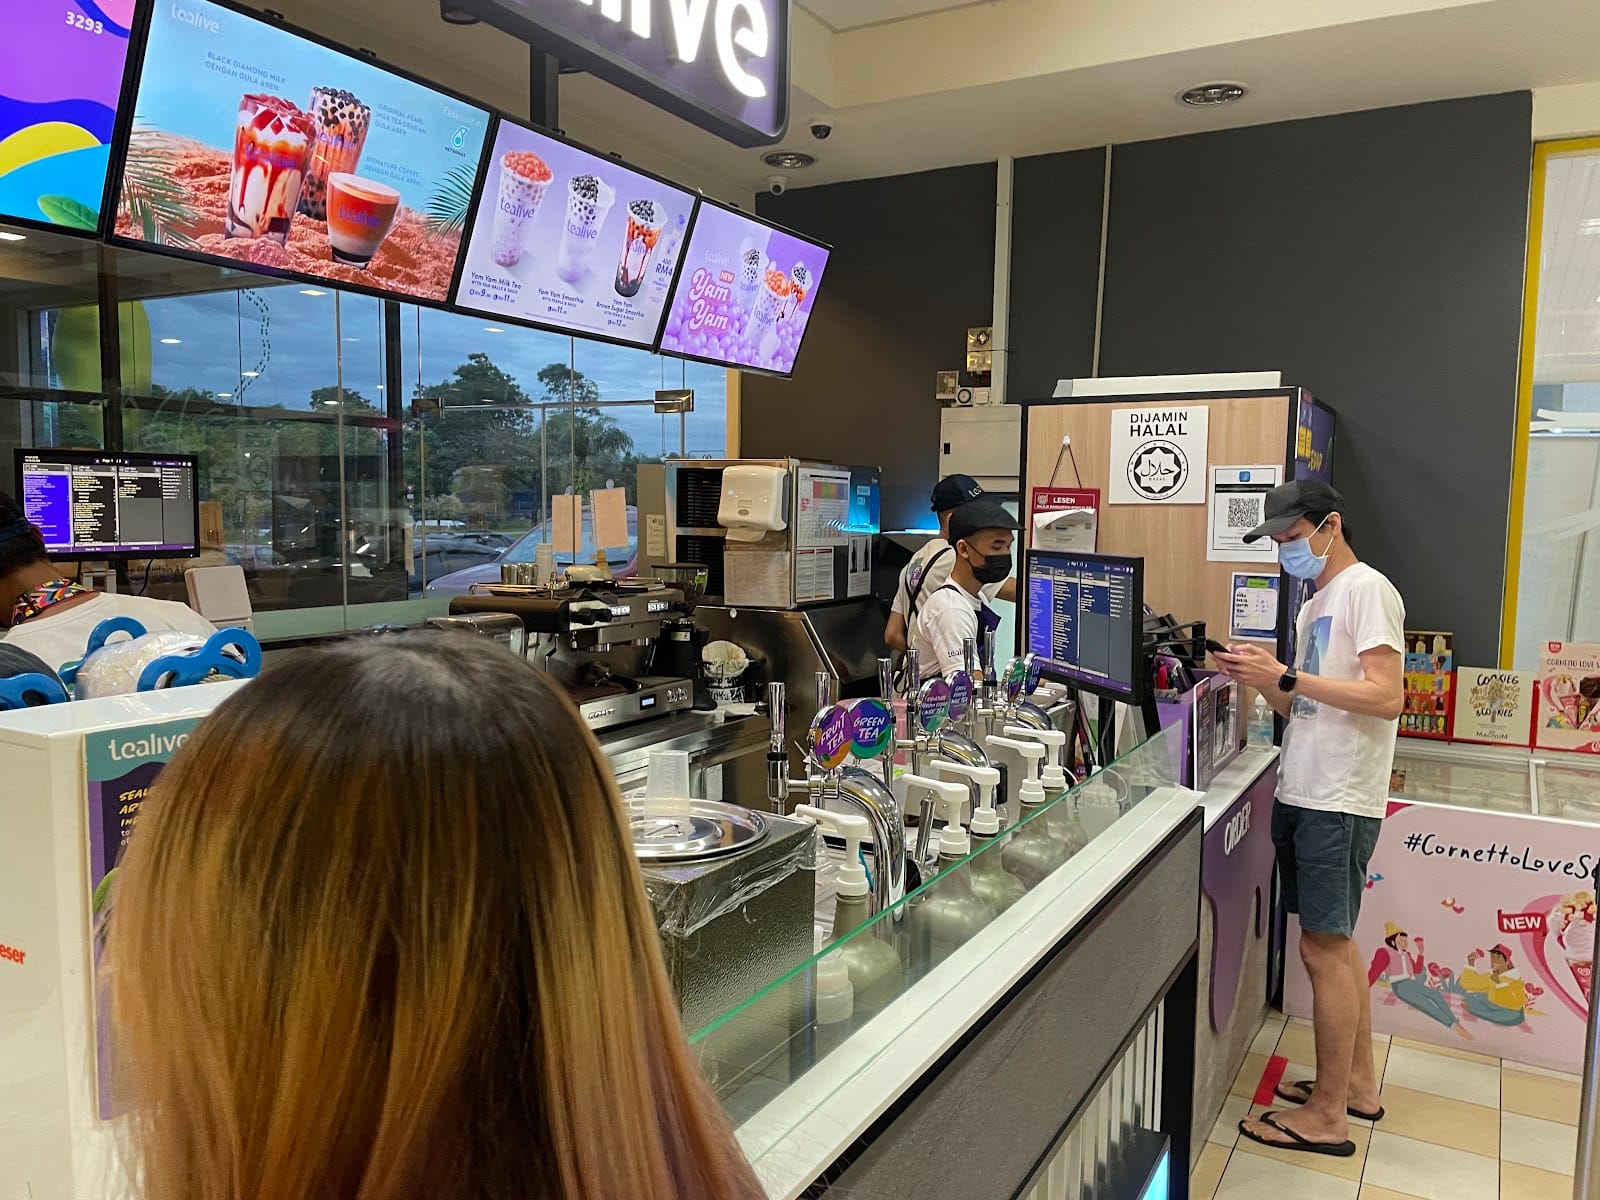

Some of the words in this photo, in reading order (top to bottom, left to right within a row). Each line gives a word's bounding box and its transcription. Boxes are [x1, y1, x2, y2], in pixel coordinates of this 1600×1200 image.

[65, 11, 103, 34] 3293
[172, 4, 220, 33] tealive
[206, 61, 238, 77] DENGAN
[239, 73, 258, 84] GULA
[260, 81, 279, 91] AREN
[208, 52, 232, 64] BLACK
[233, 61, 268, 78] DIAMOND
[270, 74, 286, 83] MILK
[500, 197, 535, 219] tealive
[567, 220, 598, 240] tealive
[472, 272, 484, 280] Yam
[486, 275, 497, 284] Yam
[499, 278, 510, 286] Milk
[689, 268, 729, 301] Yam
[721, 270, 734, 282] NEW
[539, 288, 549, 296] Yam
[550, 291, 561, 299] Yam
[562, 293, 584, 304] Smoothie
[689, 299, 729, 330] Yam
[1130, 412, 1187, 423] DIJAMIN
[1130, 424, 1187, 437] HALAL
[820, 712, 846, 745] FRUIT
[854, 716, 885, 727] GREEN
[827, 730, 845, 750] TEA
[859, 728, 880, 738] TEA
[1224, 801, 1251, 856] ORDER
[1503, 917, 1541, 930] NEW
